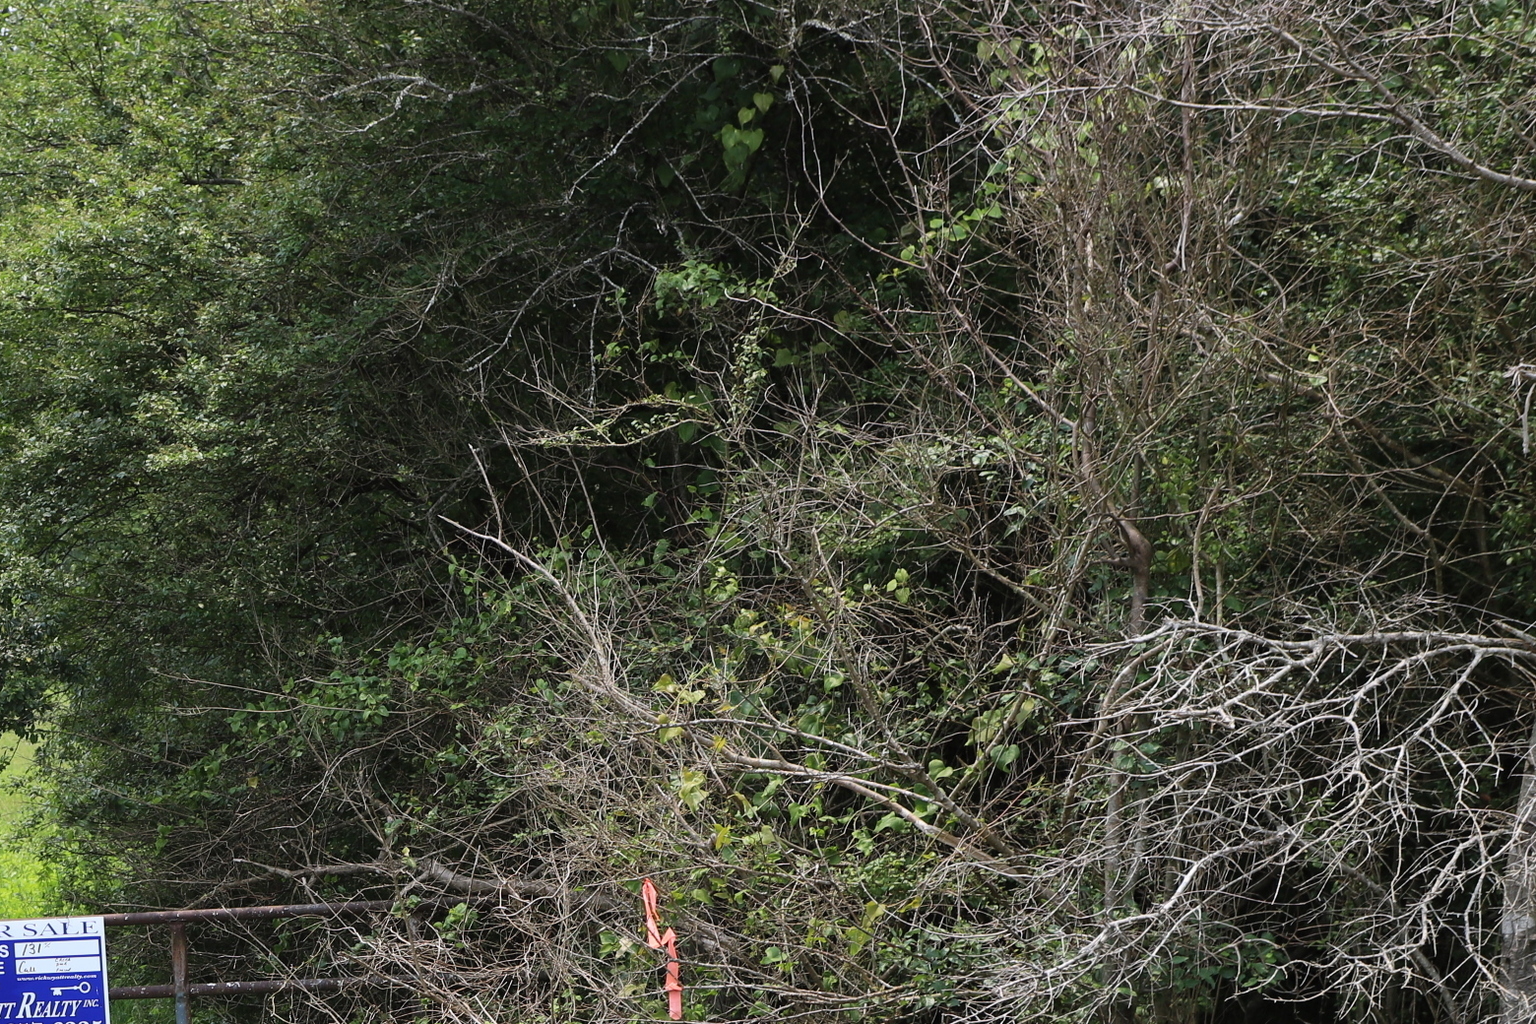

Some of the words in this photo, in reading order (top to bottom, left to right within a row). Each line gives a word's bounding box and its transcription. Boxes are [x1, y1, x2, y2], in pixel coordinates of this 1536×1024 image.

[23, 920, 99, 936] SALE
[16, 974, 98, 982] www.rickwyattrealty.com
[16, 992, 82, 1019] REALTY
